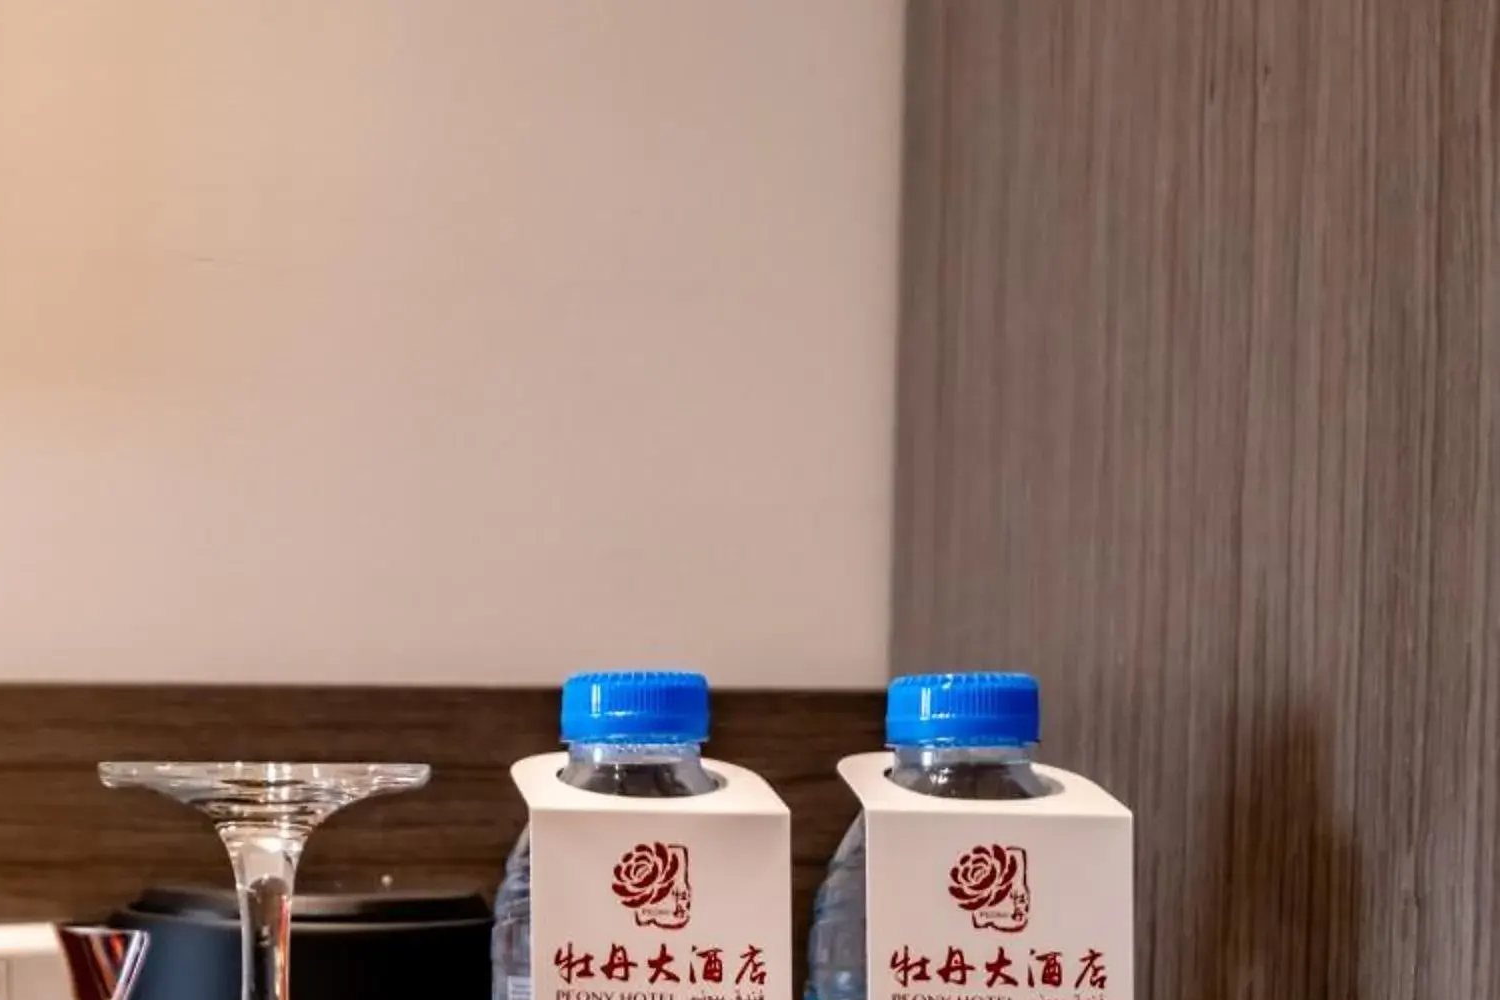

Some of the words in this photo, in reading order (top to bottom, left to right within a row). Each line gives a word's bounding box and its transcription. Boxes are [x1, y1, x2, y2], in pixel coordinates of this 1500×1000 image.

[553, 940, 769, 985] 牡丹大酒店
[889, 945, 1108, 990] 牡丹大酒店
